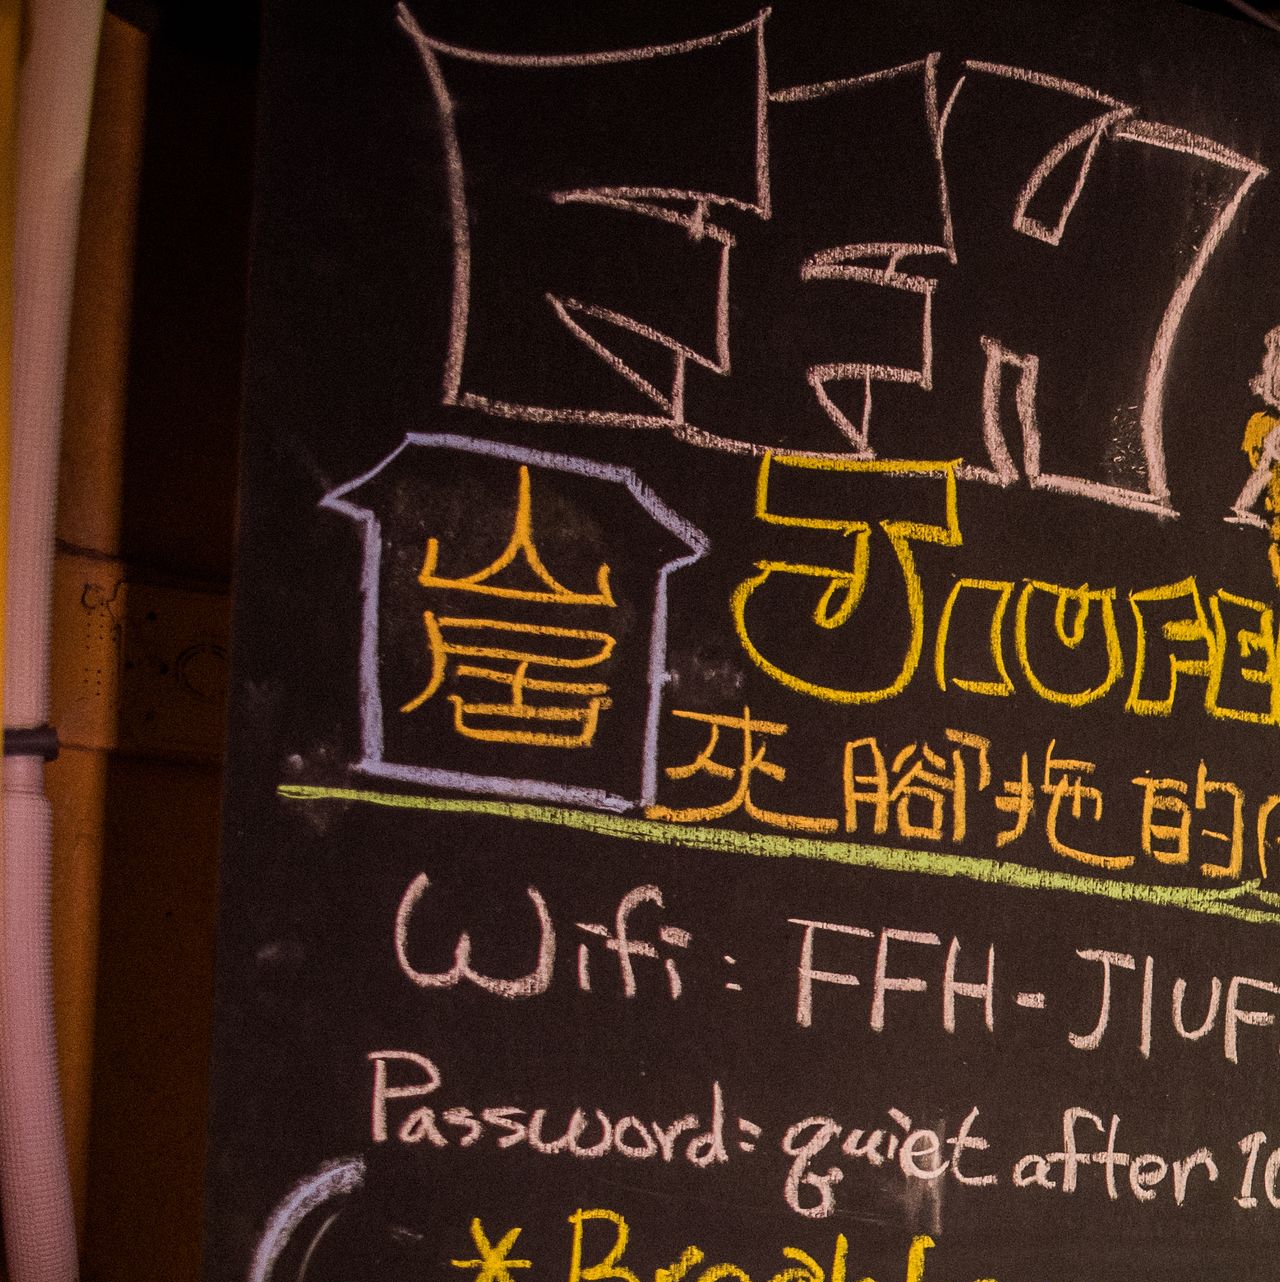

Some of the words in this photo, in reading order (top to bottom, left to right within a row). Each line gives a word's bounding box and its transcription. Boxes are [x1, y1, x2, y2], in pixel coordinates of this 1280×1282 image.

[368, 1050, 761, 1168] Password:
[781, 1105, 997, 1218] quiet
[1012, 1106, 1220, 1207] after
